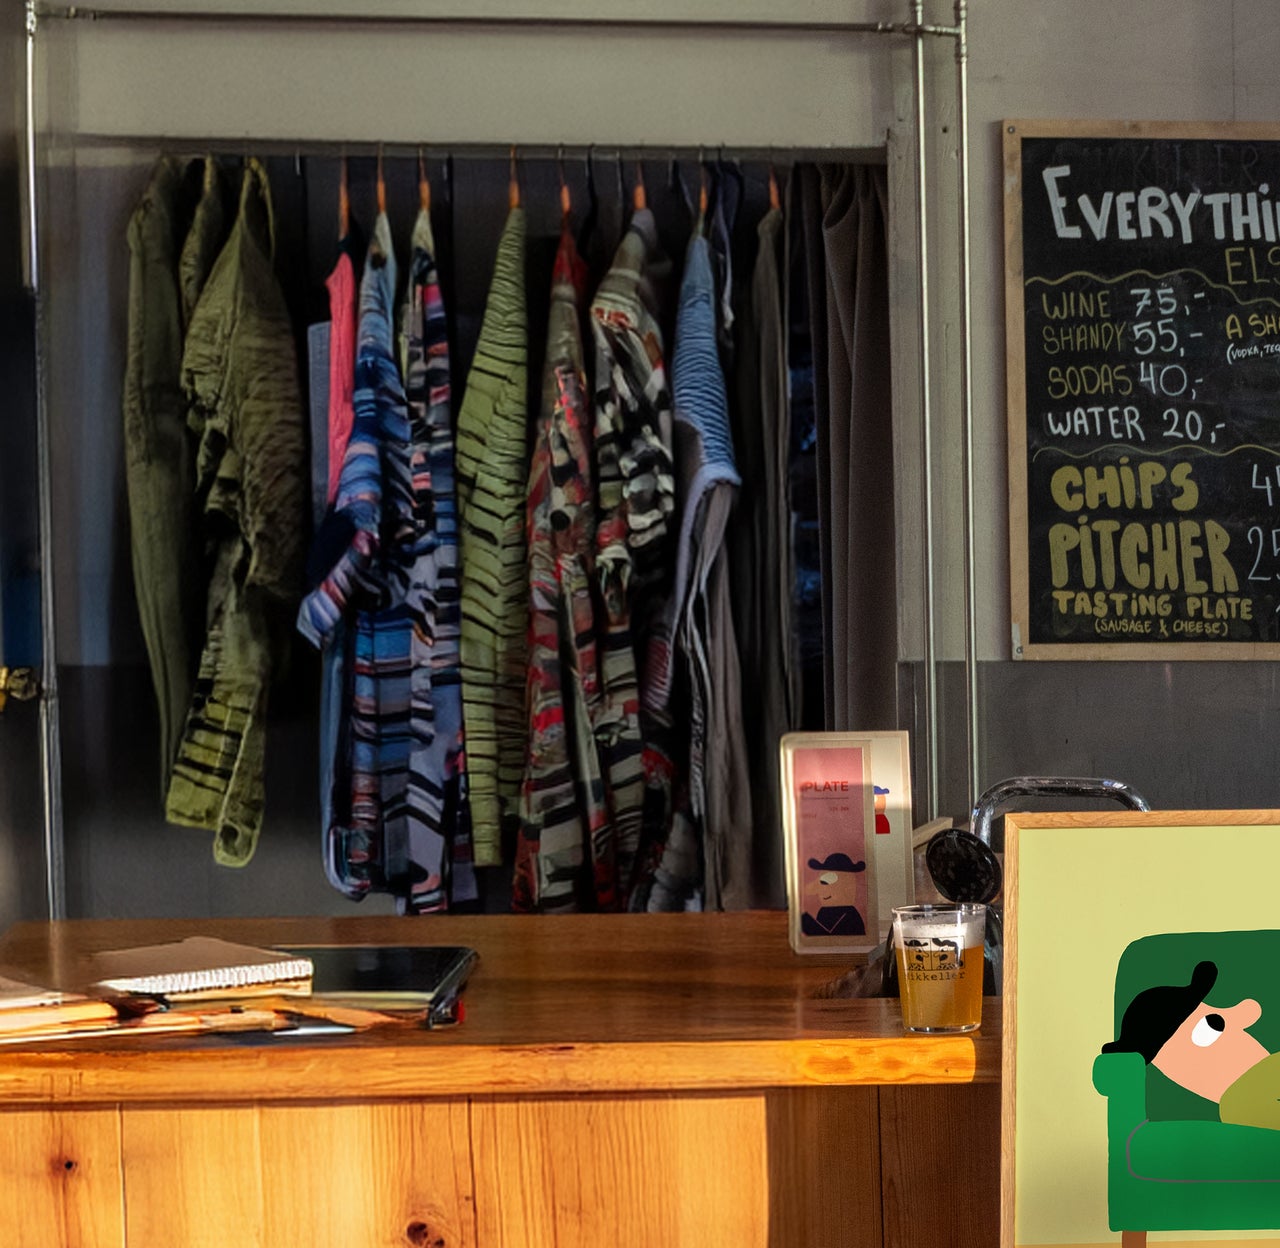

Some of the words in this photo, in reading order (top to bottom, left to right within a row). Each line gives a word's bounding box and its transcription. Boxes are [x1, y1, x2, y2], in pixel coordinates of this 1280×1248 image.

[1043, 291, 1111, 319] WINE
[1043, 321, 1126, 354] SHANDY
[1226, 314, 1242, 339] A
[1047, 363, 1132, 399] SODAS
[1048, 406, 1145, 441] WATER
[1187, 597, 1252, 621] PLATE
[1095, 618, 1151, 634] (SAUSAGE
[907, 970, 966, 981] ikkeller
